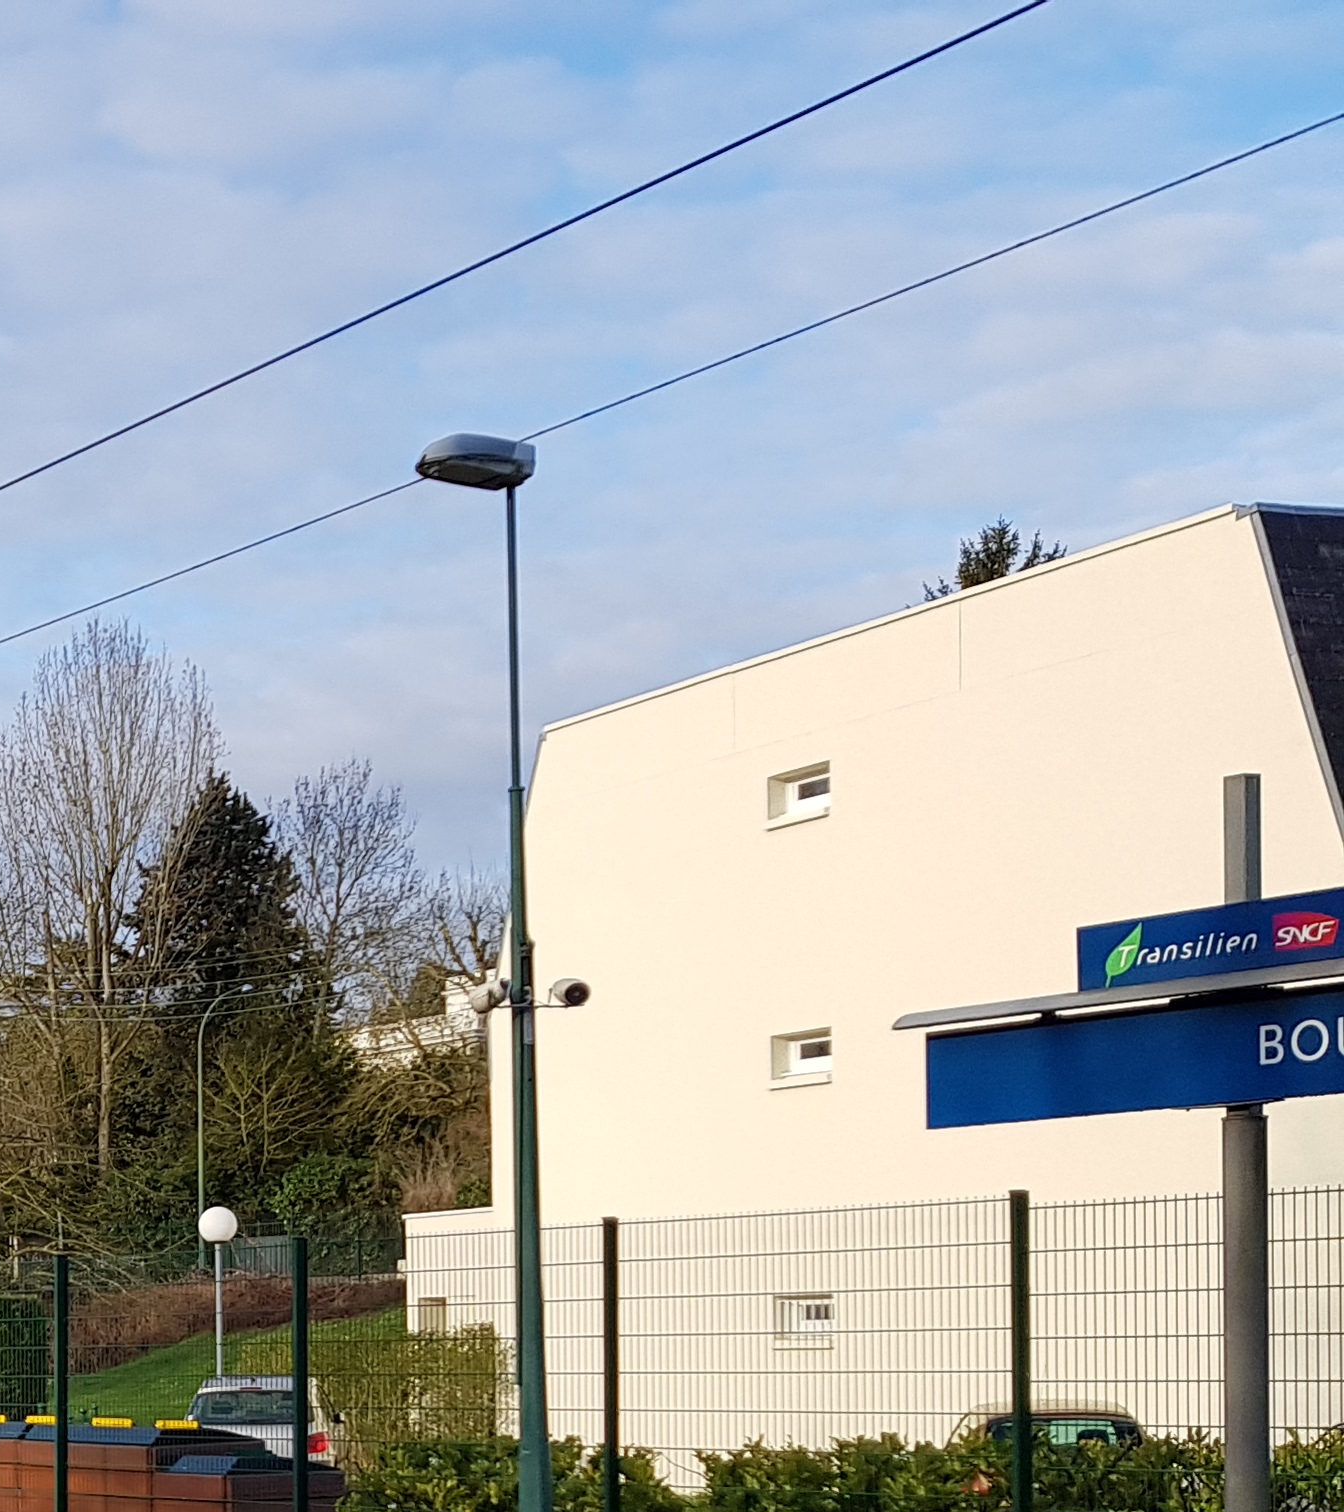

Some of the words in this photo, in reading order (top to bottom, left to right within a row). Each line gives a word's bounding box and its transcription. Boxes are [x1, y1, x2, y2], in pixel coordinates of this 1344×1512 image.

[1117, 931, 1259, 968] Transilien
[1274, 919, 1336, 948] SNCF
[1258, 1015, 1344, 1067] BO
